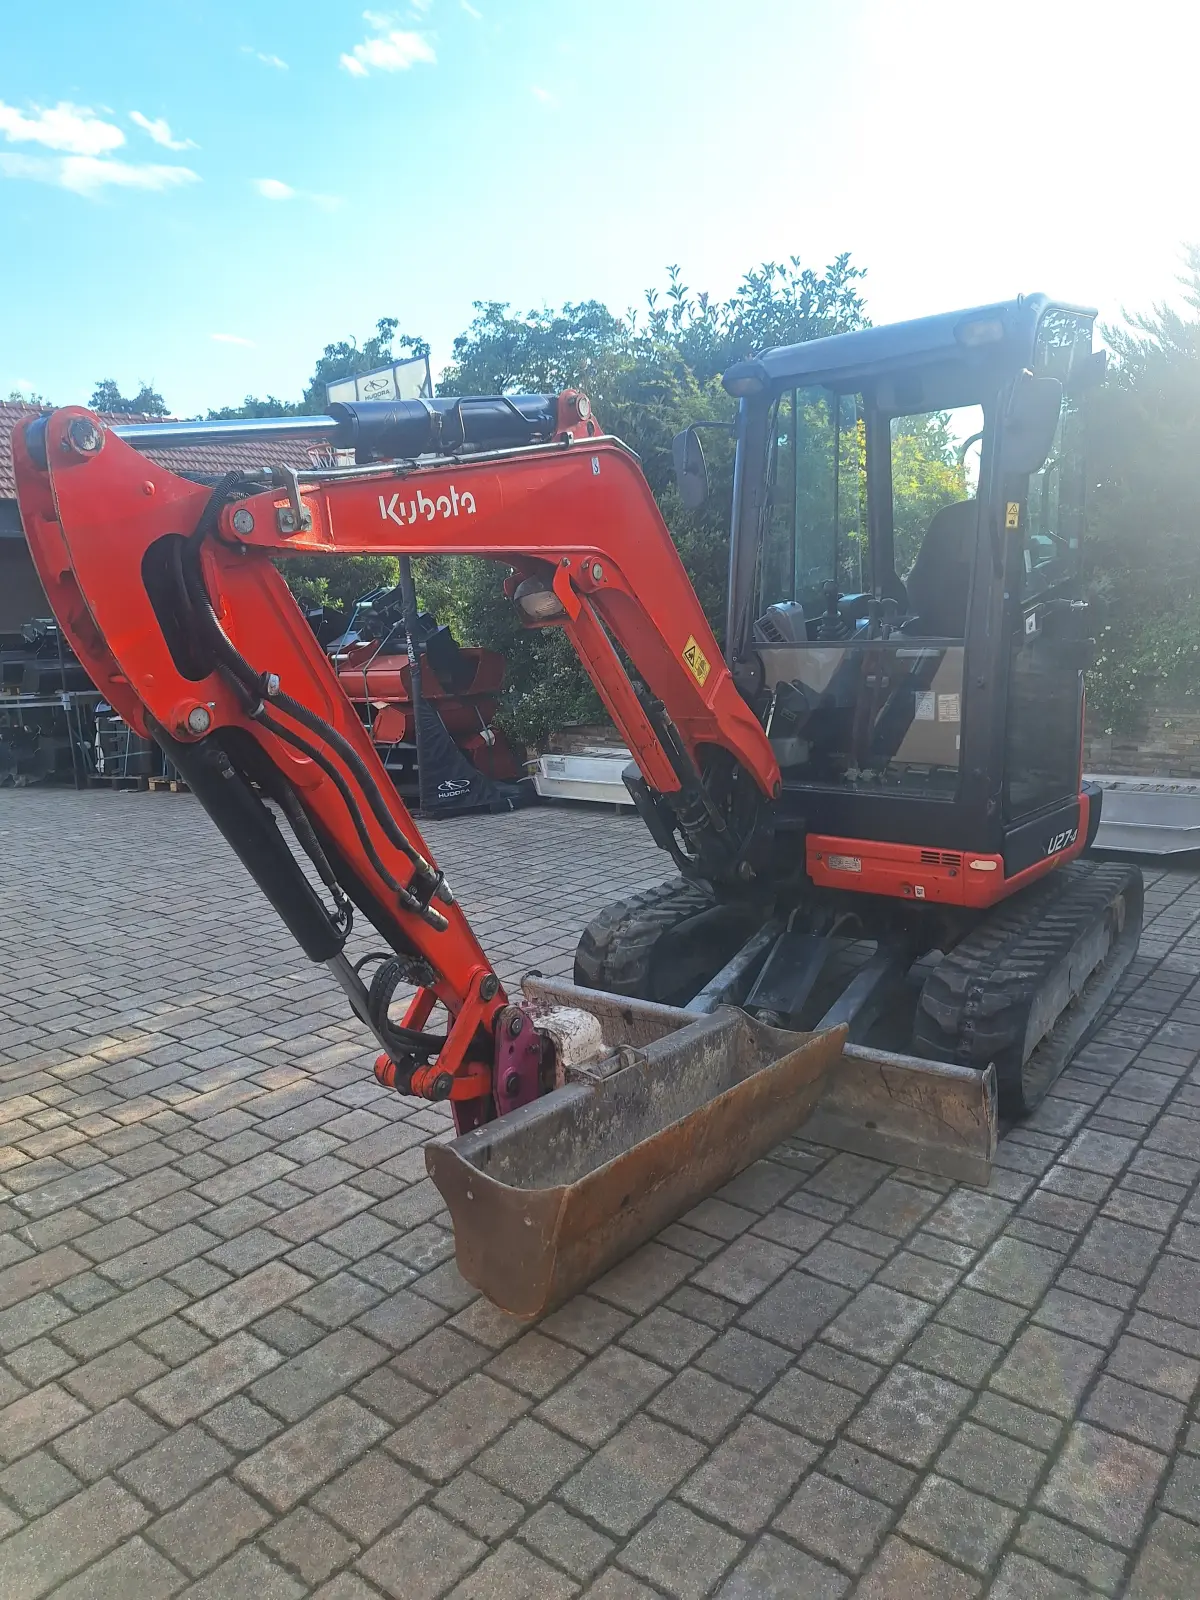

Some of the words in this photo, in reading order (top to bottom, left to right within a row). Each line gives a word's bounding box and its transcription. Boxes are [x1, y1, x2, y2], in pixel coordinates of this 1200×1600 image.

[378, 485, 476, 526] Kubota
[438, 788, 471, 799] HUDORA
[1047, 829, 1078, 855] U27-4
